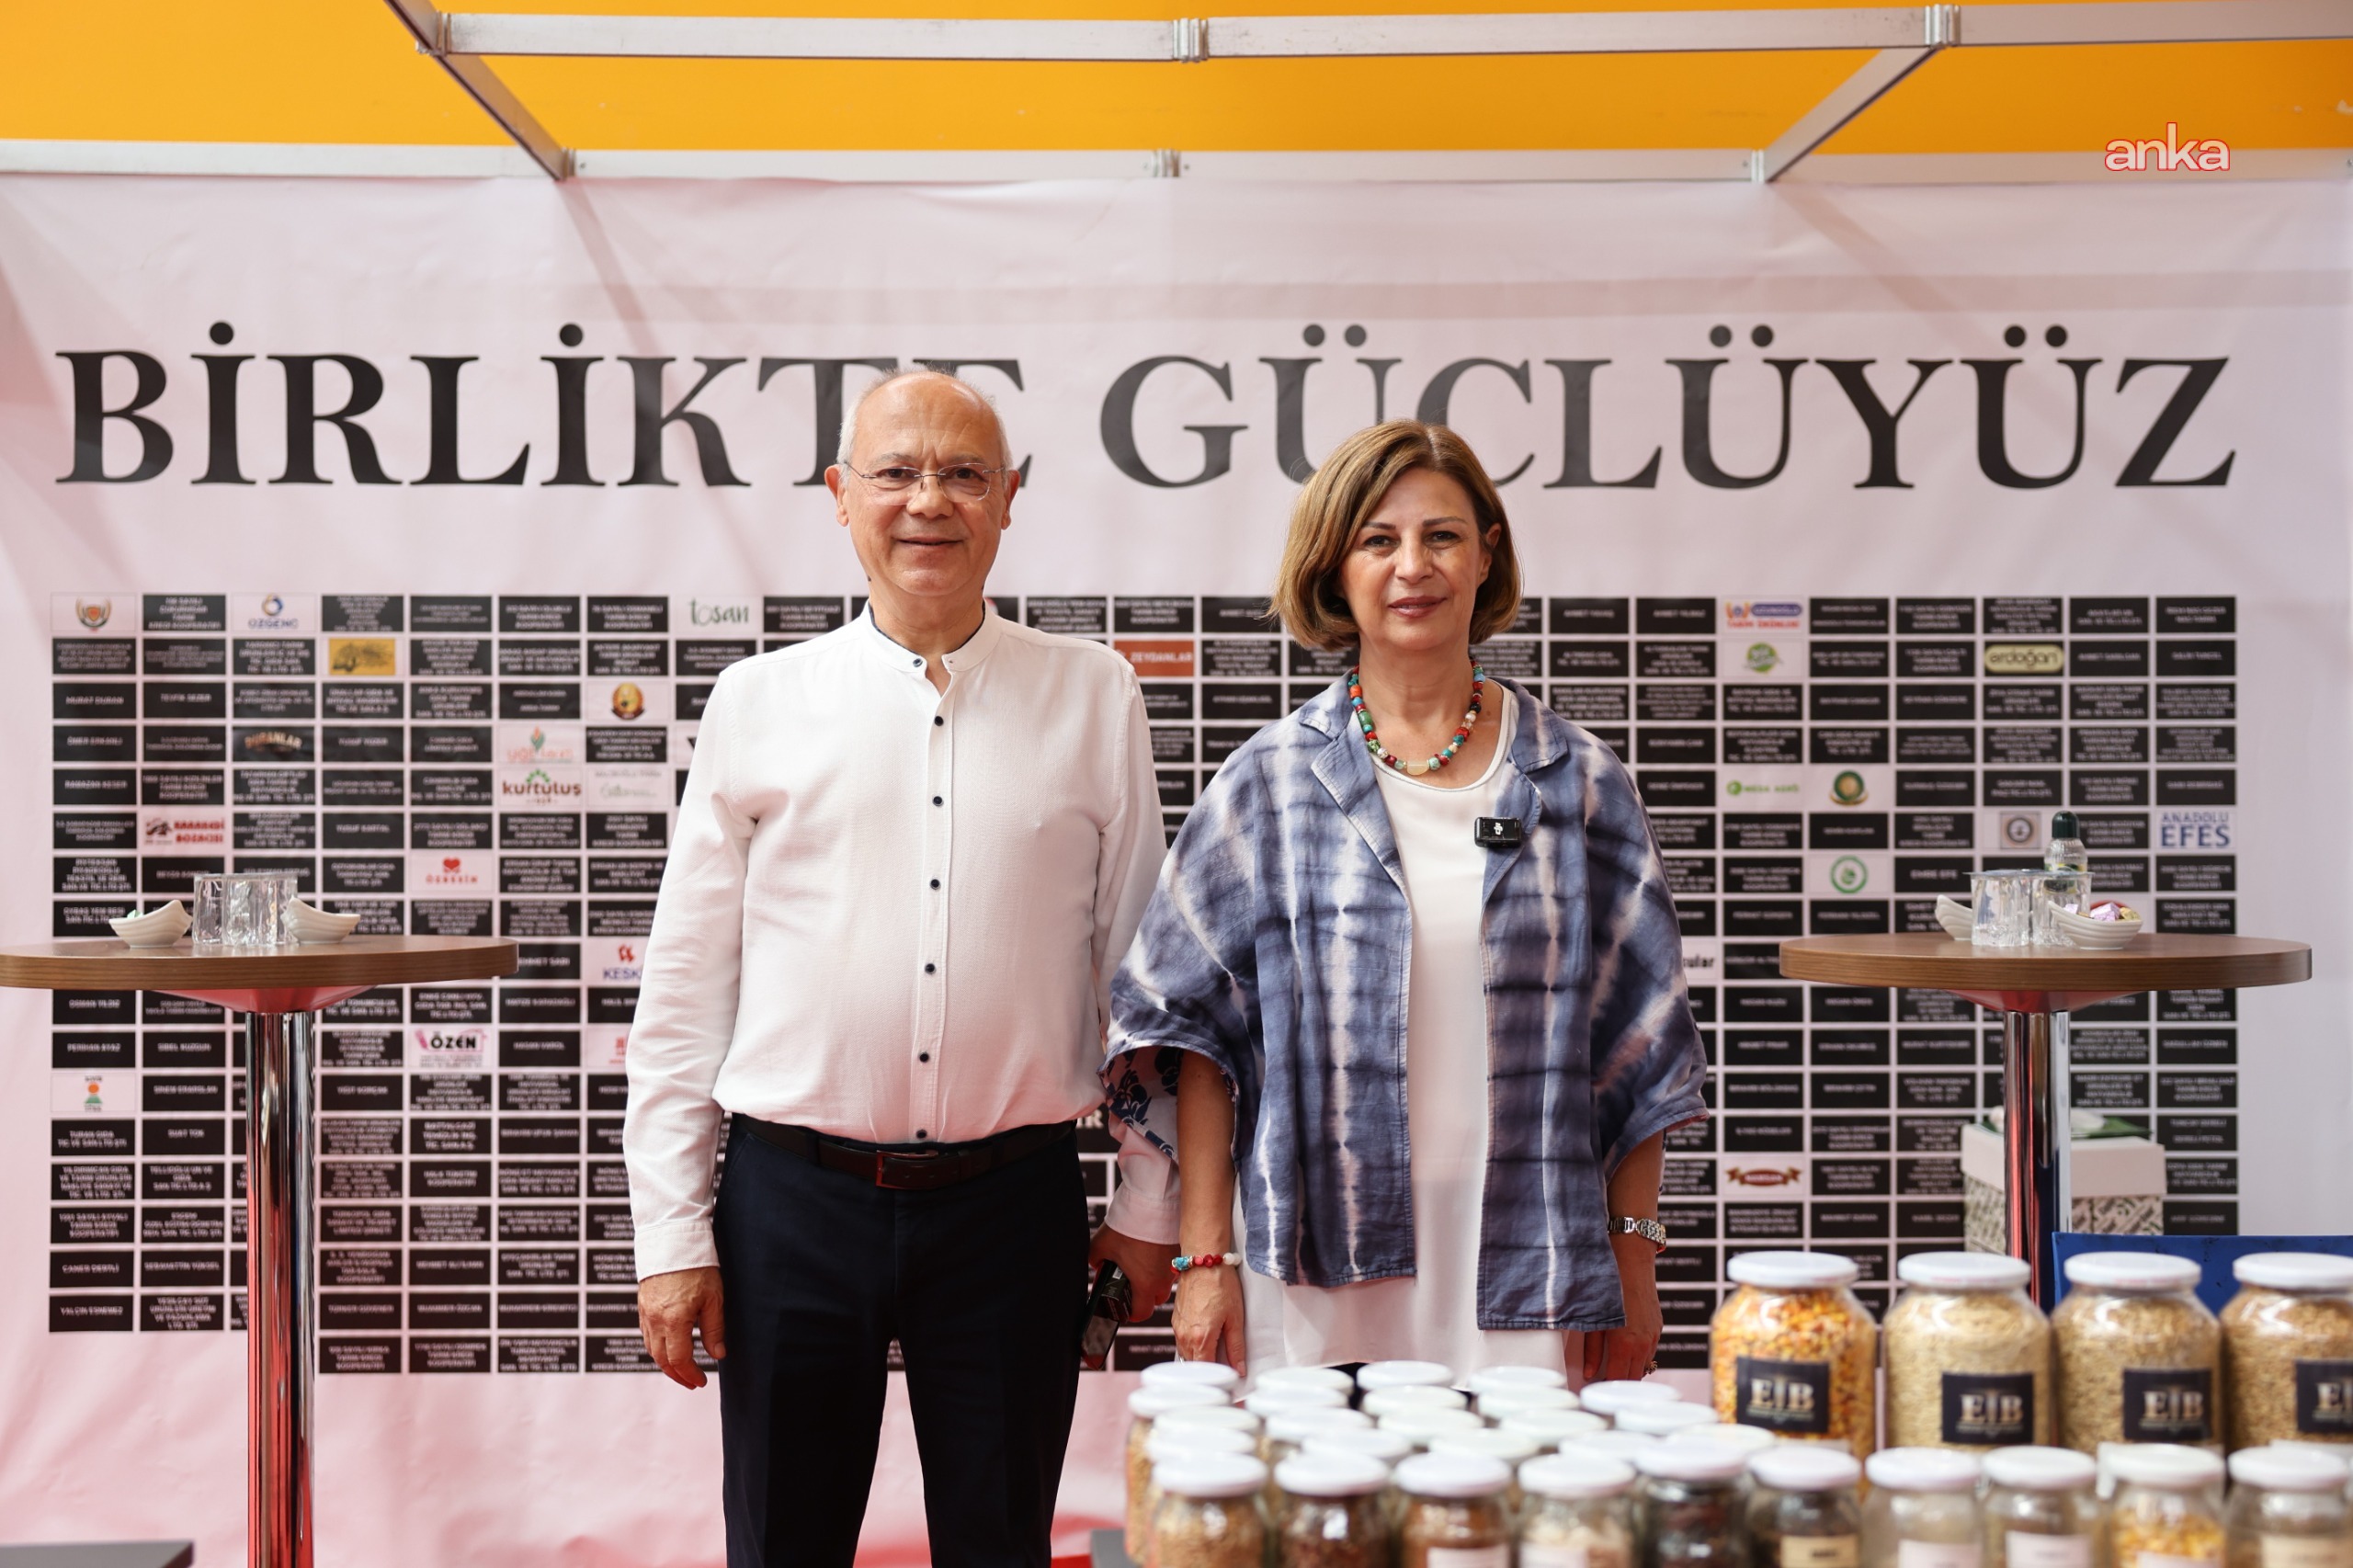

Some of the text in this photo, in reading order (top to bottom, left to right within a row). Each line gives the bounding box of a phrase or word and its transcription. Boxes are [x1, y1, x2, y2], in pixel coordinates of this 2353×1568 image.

[55, 320, 1033, 487] BİRLİKT
[689, 598, 749, 626] tosan
[502, 780, 582, 797] kurtuluş
[2161, 812, 2229, 824] ANADOLU
[2160, 827, 2231, 847] EFES
[430, 1032, 477, 1050] ÖZEN
